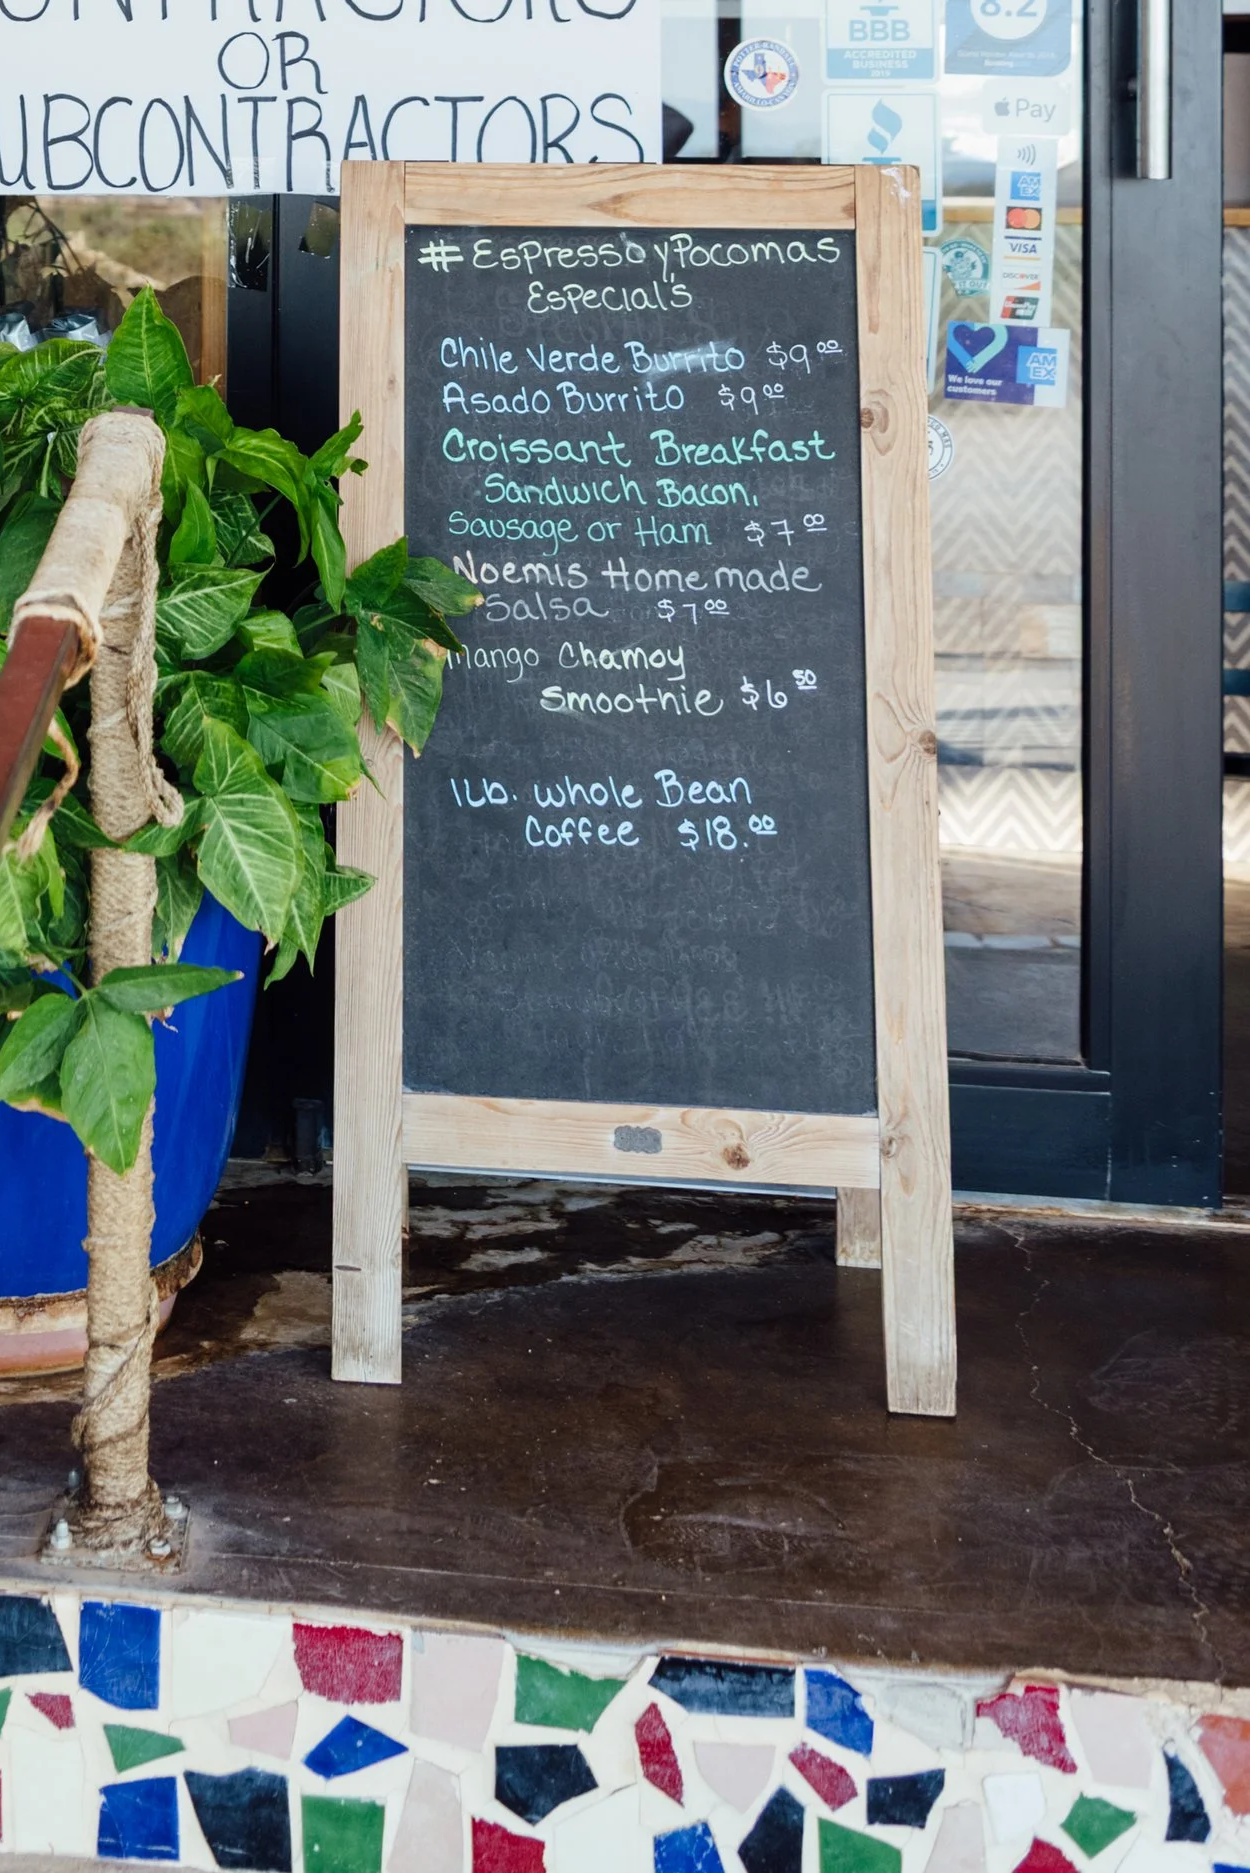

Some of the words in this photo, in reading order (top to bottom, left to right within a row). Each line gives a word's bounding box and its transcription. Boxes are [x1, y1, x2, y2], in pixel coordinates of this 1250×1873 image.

[848, 20, 910, 42] BBB
[217, 31, 328, 95] OR
[844, 50, 917, 60] ACCREDITED
[852, 60, 909, 69] BUSINESS
[1016, 98, 1056, 122] Pay
[1018, 176, 1042, 188] AM
[1019, 186, 1041, 198] EX
[1009, 243, 1037, 254] VISA
[1002, 272, 1040, 280] DISCOVER
[440, 337, 518, 374] Chile
[625, 341, 744, 374] Burrito
[1027, 352, 1057, 366] AM
[947, 374, 963, 383] We
[964, 376, 984, 385] love
[986, 378, 1003, 387] our
[1031, 366, 1056, 380] EX
[442, 382, 550, 414] Asado
[556, 381, 684, 414] Burrito
[947, 385, 997, 396] customers
[443, 428, 632, 467] Croissant
[650, 429, 836, 466] Breakfast
[485, 473, 647, 505] Sandwich
[448, 511, 578, 556] Sausage
[587, 521, 622, 542] or
[635, 516, 712, 547] Ham
[452, 550, 588, 589] Noemis
[485, 592, 609, 622] Salsa
[445, 644, 539, 683] Mango
[559, 641, 686, 681] Chamoy
[654, 768, 752, 807] Bean
[525, 814, 640, 847] Coffee
